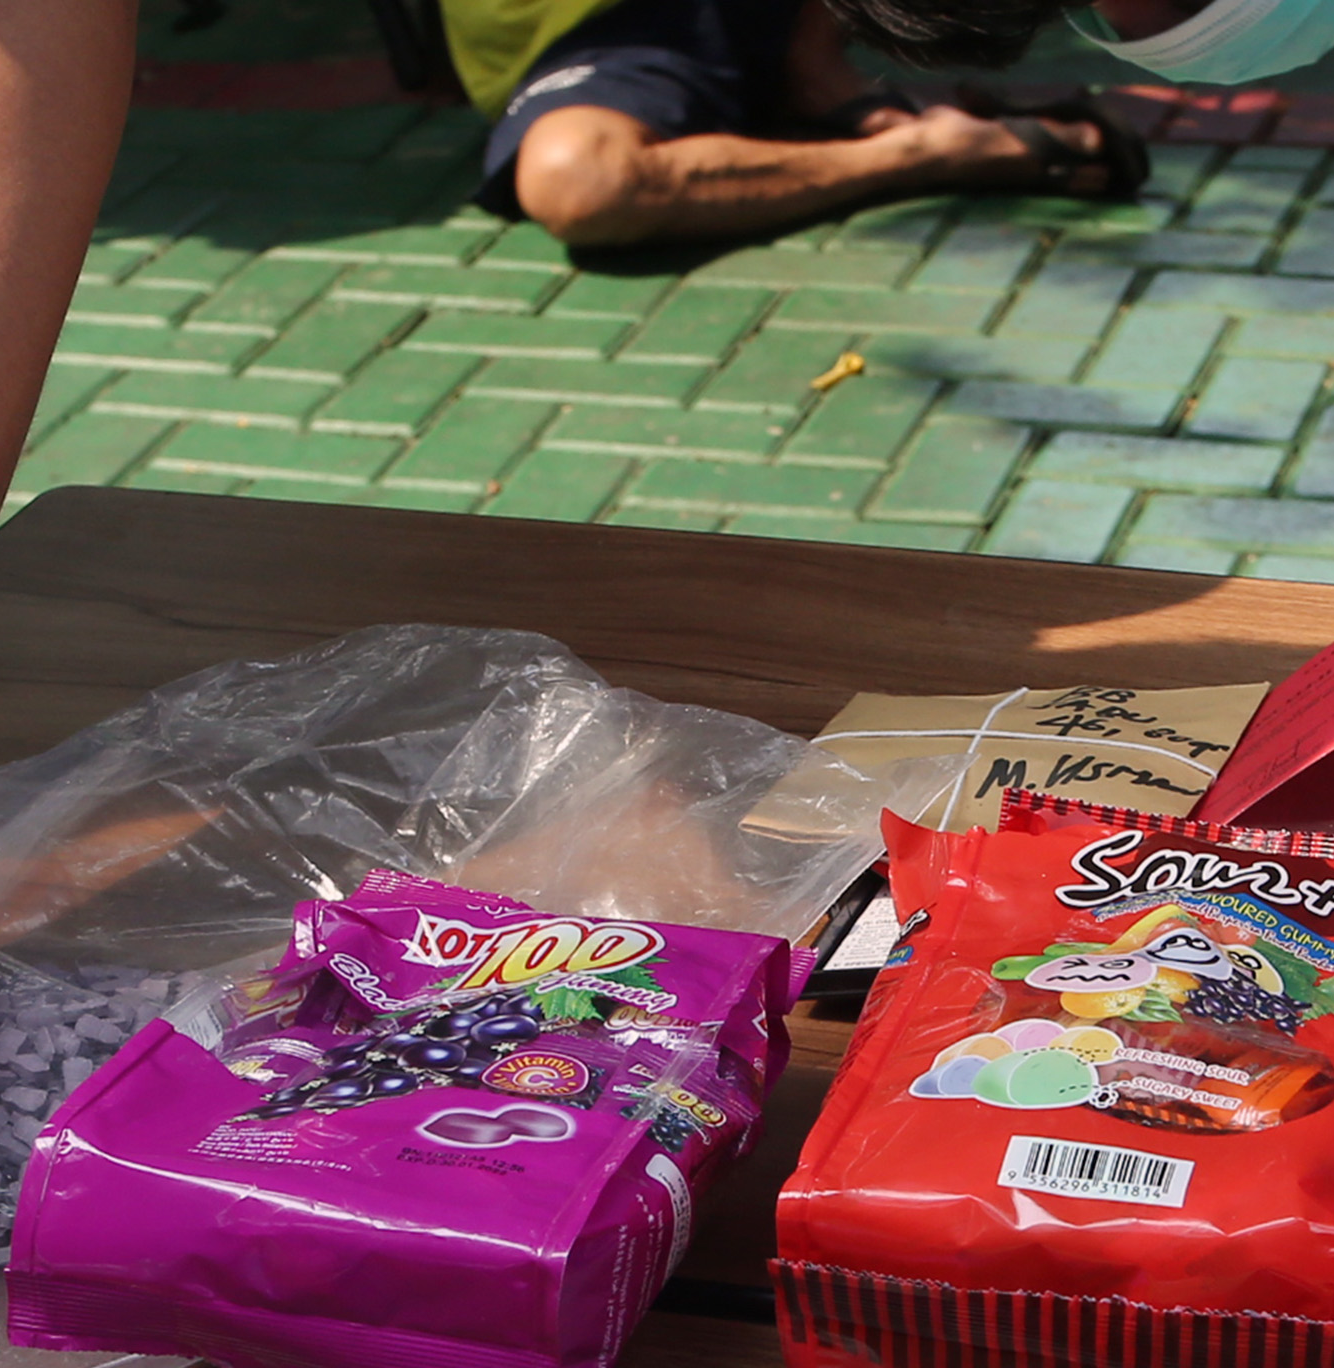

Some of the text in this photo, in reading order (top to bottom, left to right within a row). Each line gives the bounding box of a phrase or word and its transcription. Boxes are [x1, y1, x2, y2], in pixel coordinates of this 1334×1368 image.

[455, 917, 663, 991] 100
[499, 1056, 575, 1079] Vitamin
[513, 1066, 559, 1089] C
[1115, 1048, 1250, 1085] REFRESHING SOUR
[1132, 1077, 1242, 1109] SUGARY SWEET
[1007, 1170, 1161, 1199] 9 556296 311814
